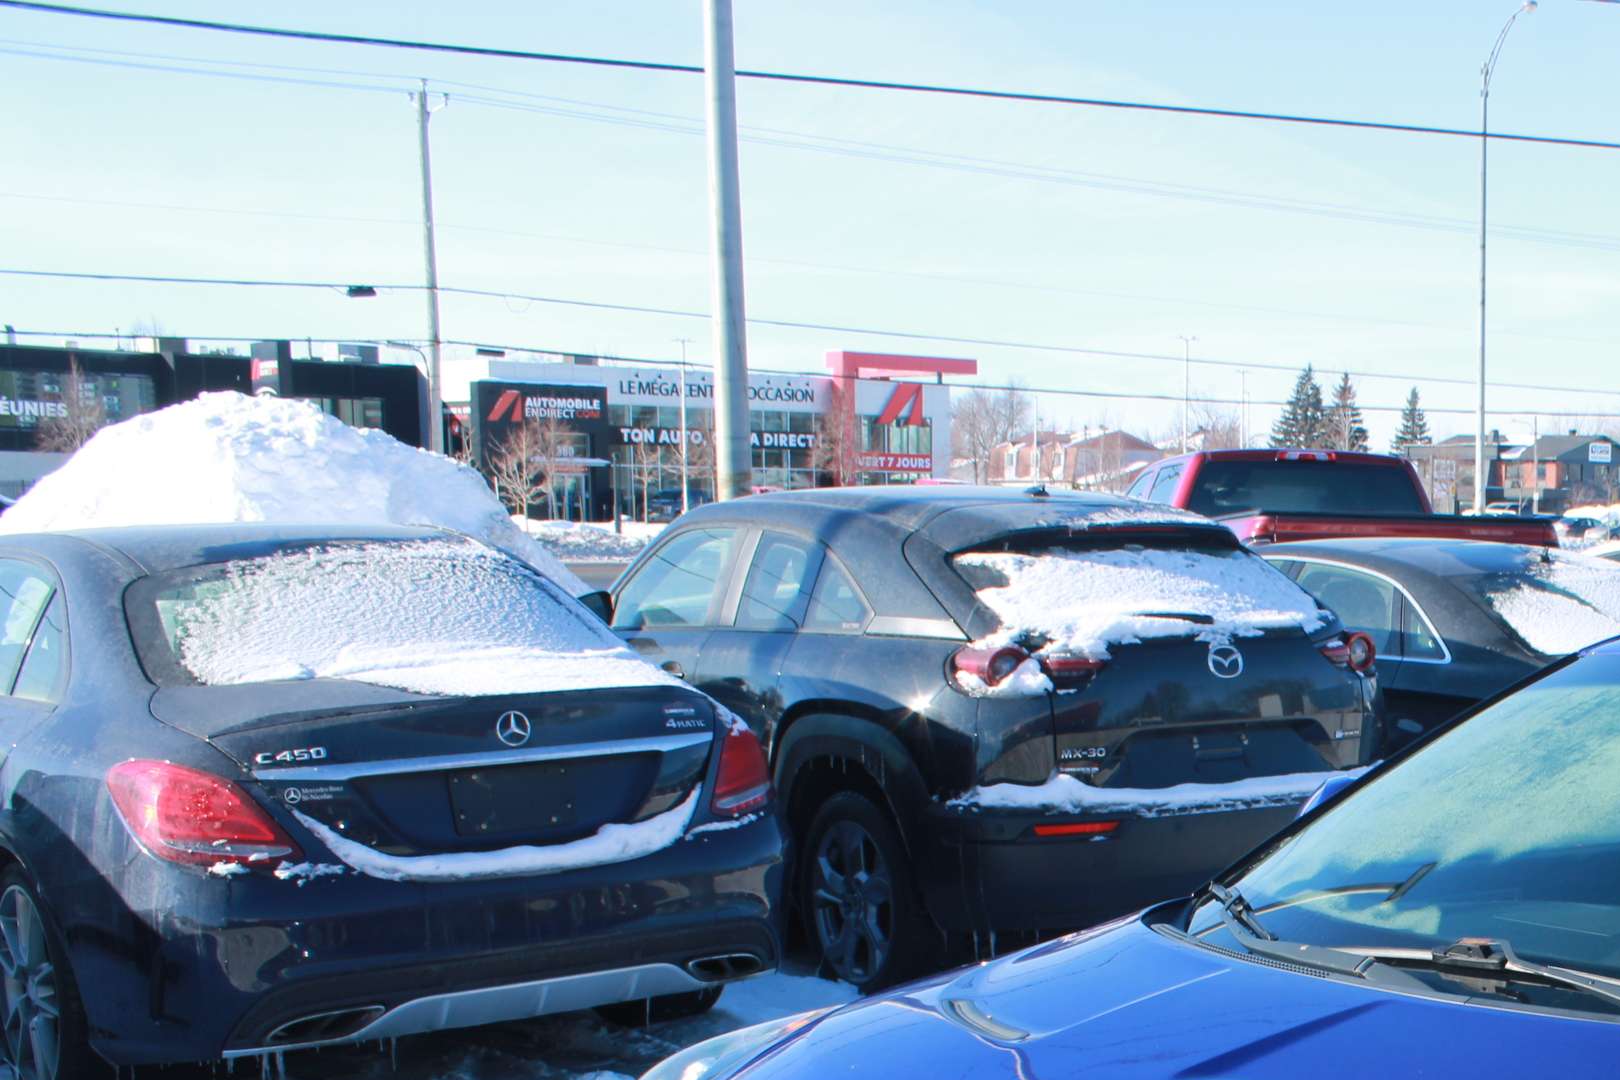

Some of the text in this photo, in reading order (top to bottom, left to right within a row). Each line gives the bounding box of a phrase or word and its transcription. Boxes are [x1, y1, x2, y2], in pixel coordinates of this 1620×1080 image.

[619, 380, 636, 395] LE
[525, 397, 601, 410] AUTOMOBILE
[620, 427, 655, 445] TON
[887, 456, 895, 467] 7
[895, 457, 931, 468] JOURS
[1061, 747, 1106, 759] MX-30
